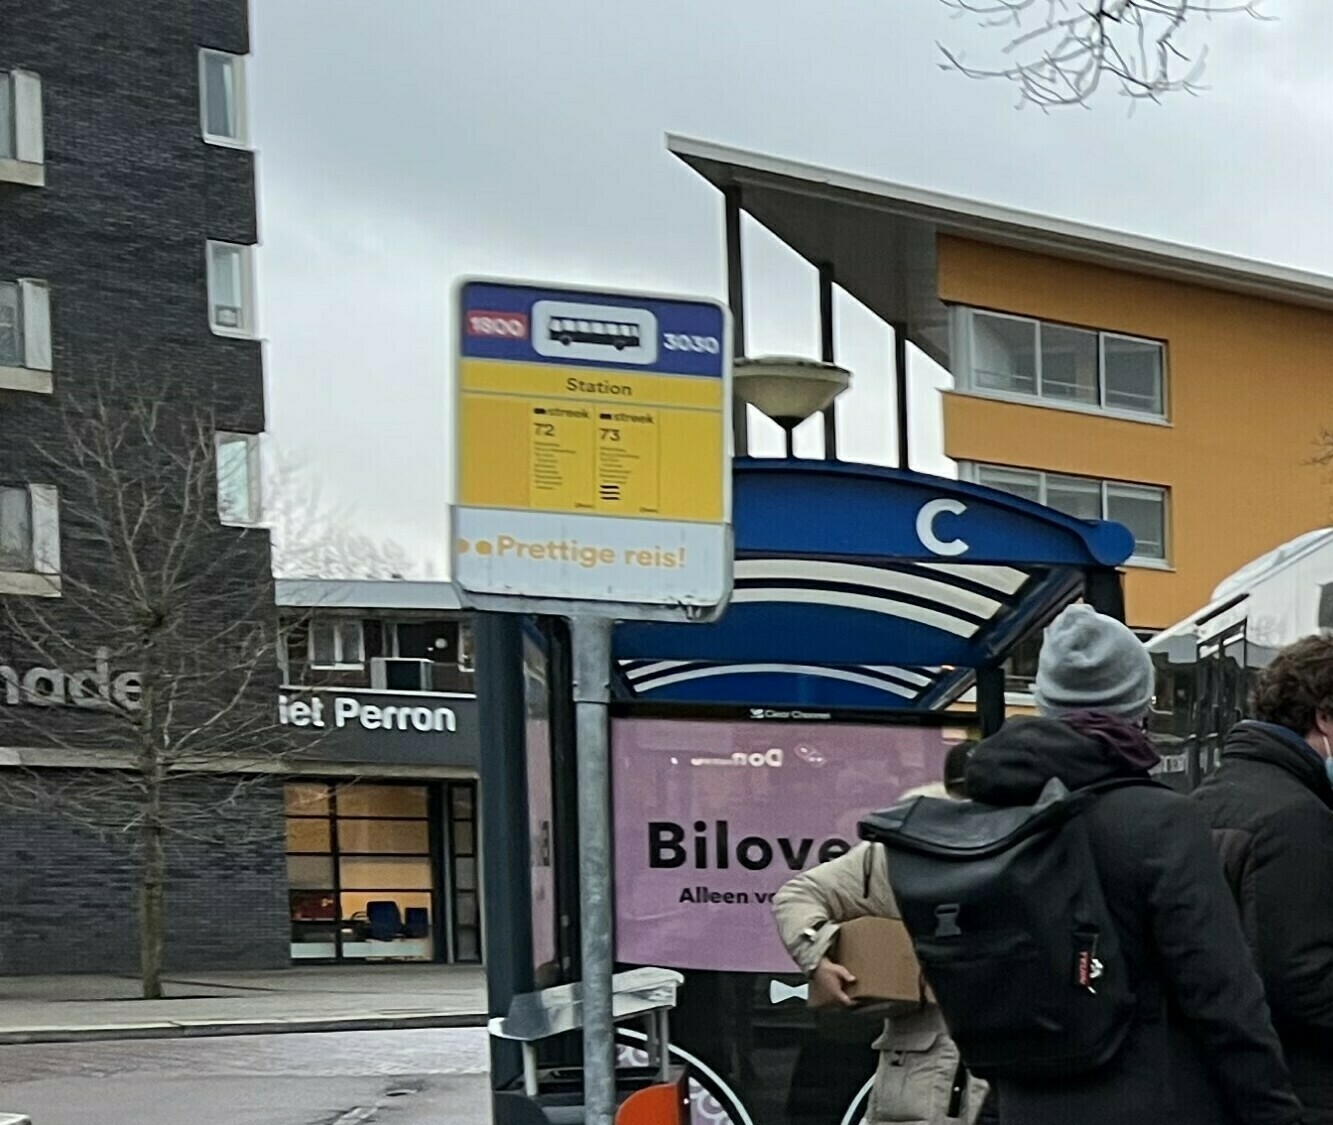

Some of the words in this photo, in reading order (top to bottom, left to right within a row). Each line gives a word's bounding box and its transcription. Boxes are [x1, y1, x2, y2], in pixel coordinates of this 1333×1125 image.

[662, 332, 720, 354] 3030
[566, 377, 633, 397] Station
[533, 422, 556, 437] 72
[599, 428, 621, 442] 73
[916, 498, 970, 556] C
[497, 534, 616, 568] Prettige
[624, 545, 686, 568] reis!
[335, 697, 457, 733] Perron
[679, 886, 749, 904] Alleen
